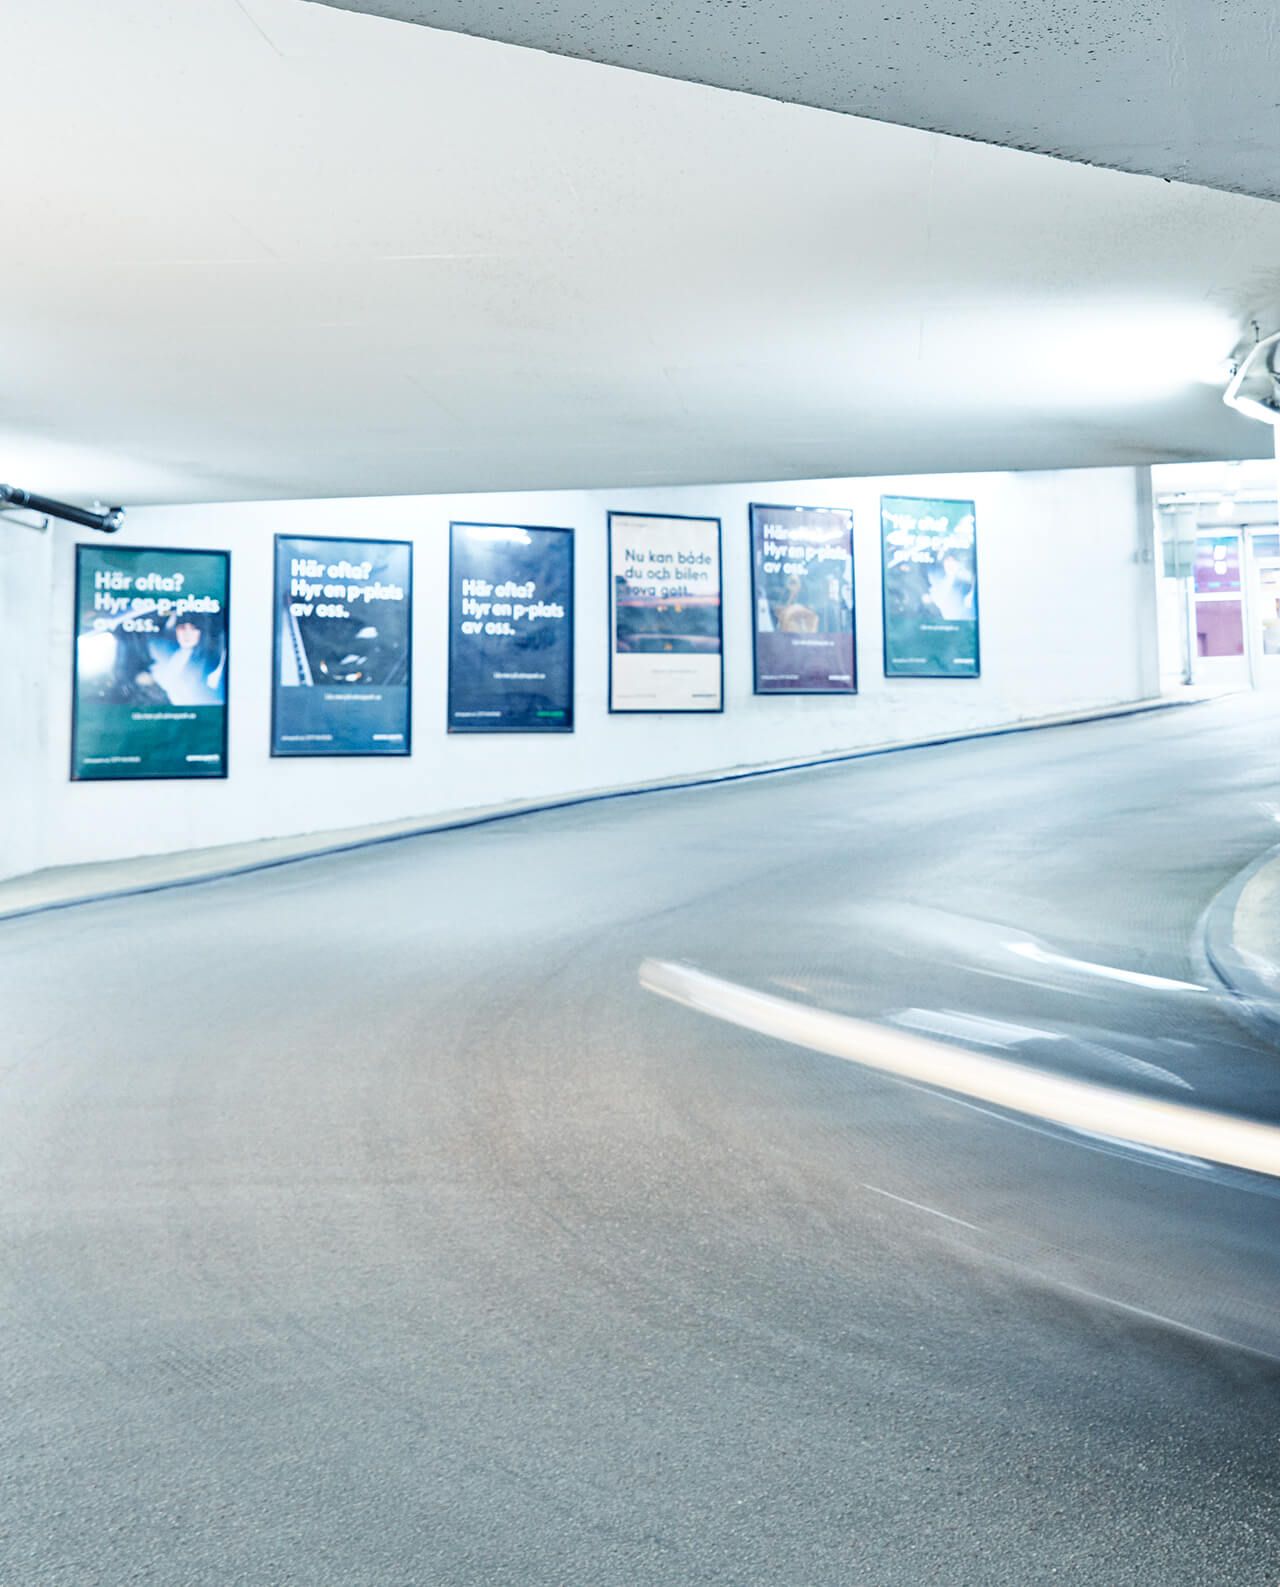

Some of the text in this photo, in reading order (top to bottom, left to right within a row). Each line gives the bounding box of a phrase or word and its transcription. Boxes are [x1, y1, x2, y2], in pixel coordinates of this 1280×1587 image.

[625, 549, 712, 565] Nu kan både
[763, 541, 787, 561] Hyr
[290, 558, 372, 580] Här ofta?
[625, 566, 708, 580] du och bilen
[763, 562, 782, 574] av
[95, 571, 184, 592] Här ofta?
[290, 578, 404, 604] Hyr en p-plats
[462, 578, 536, 599] Här ofta?
[94, 591, 129, 615] Hyr
[157, 593, 220, 616] p-plats
[289, 602, 350, 619] av oss.
[462, 598, 565, 621] Hyr en p-plats
[122, 617, 160, 633] oss.
[461, 621, 516, 635] av oss.
